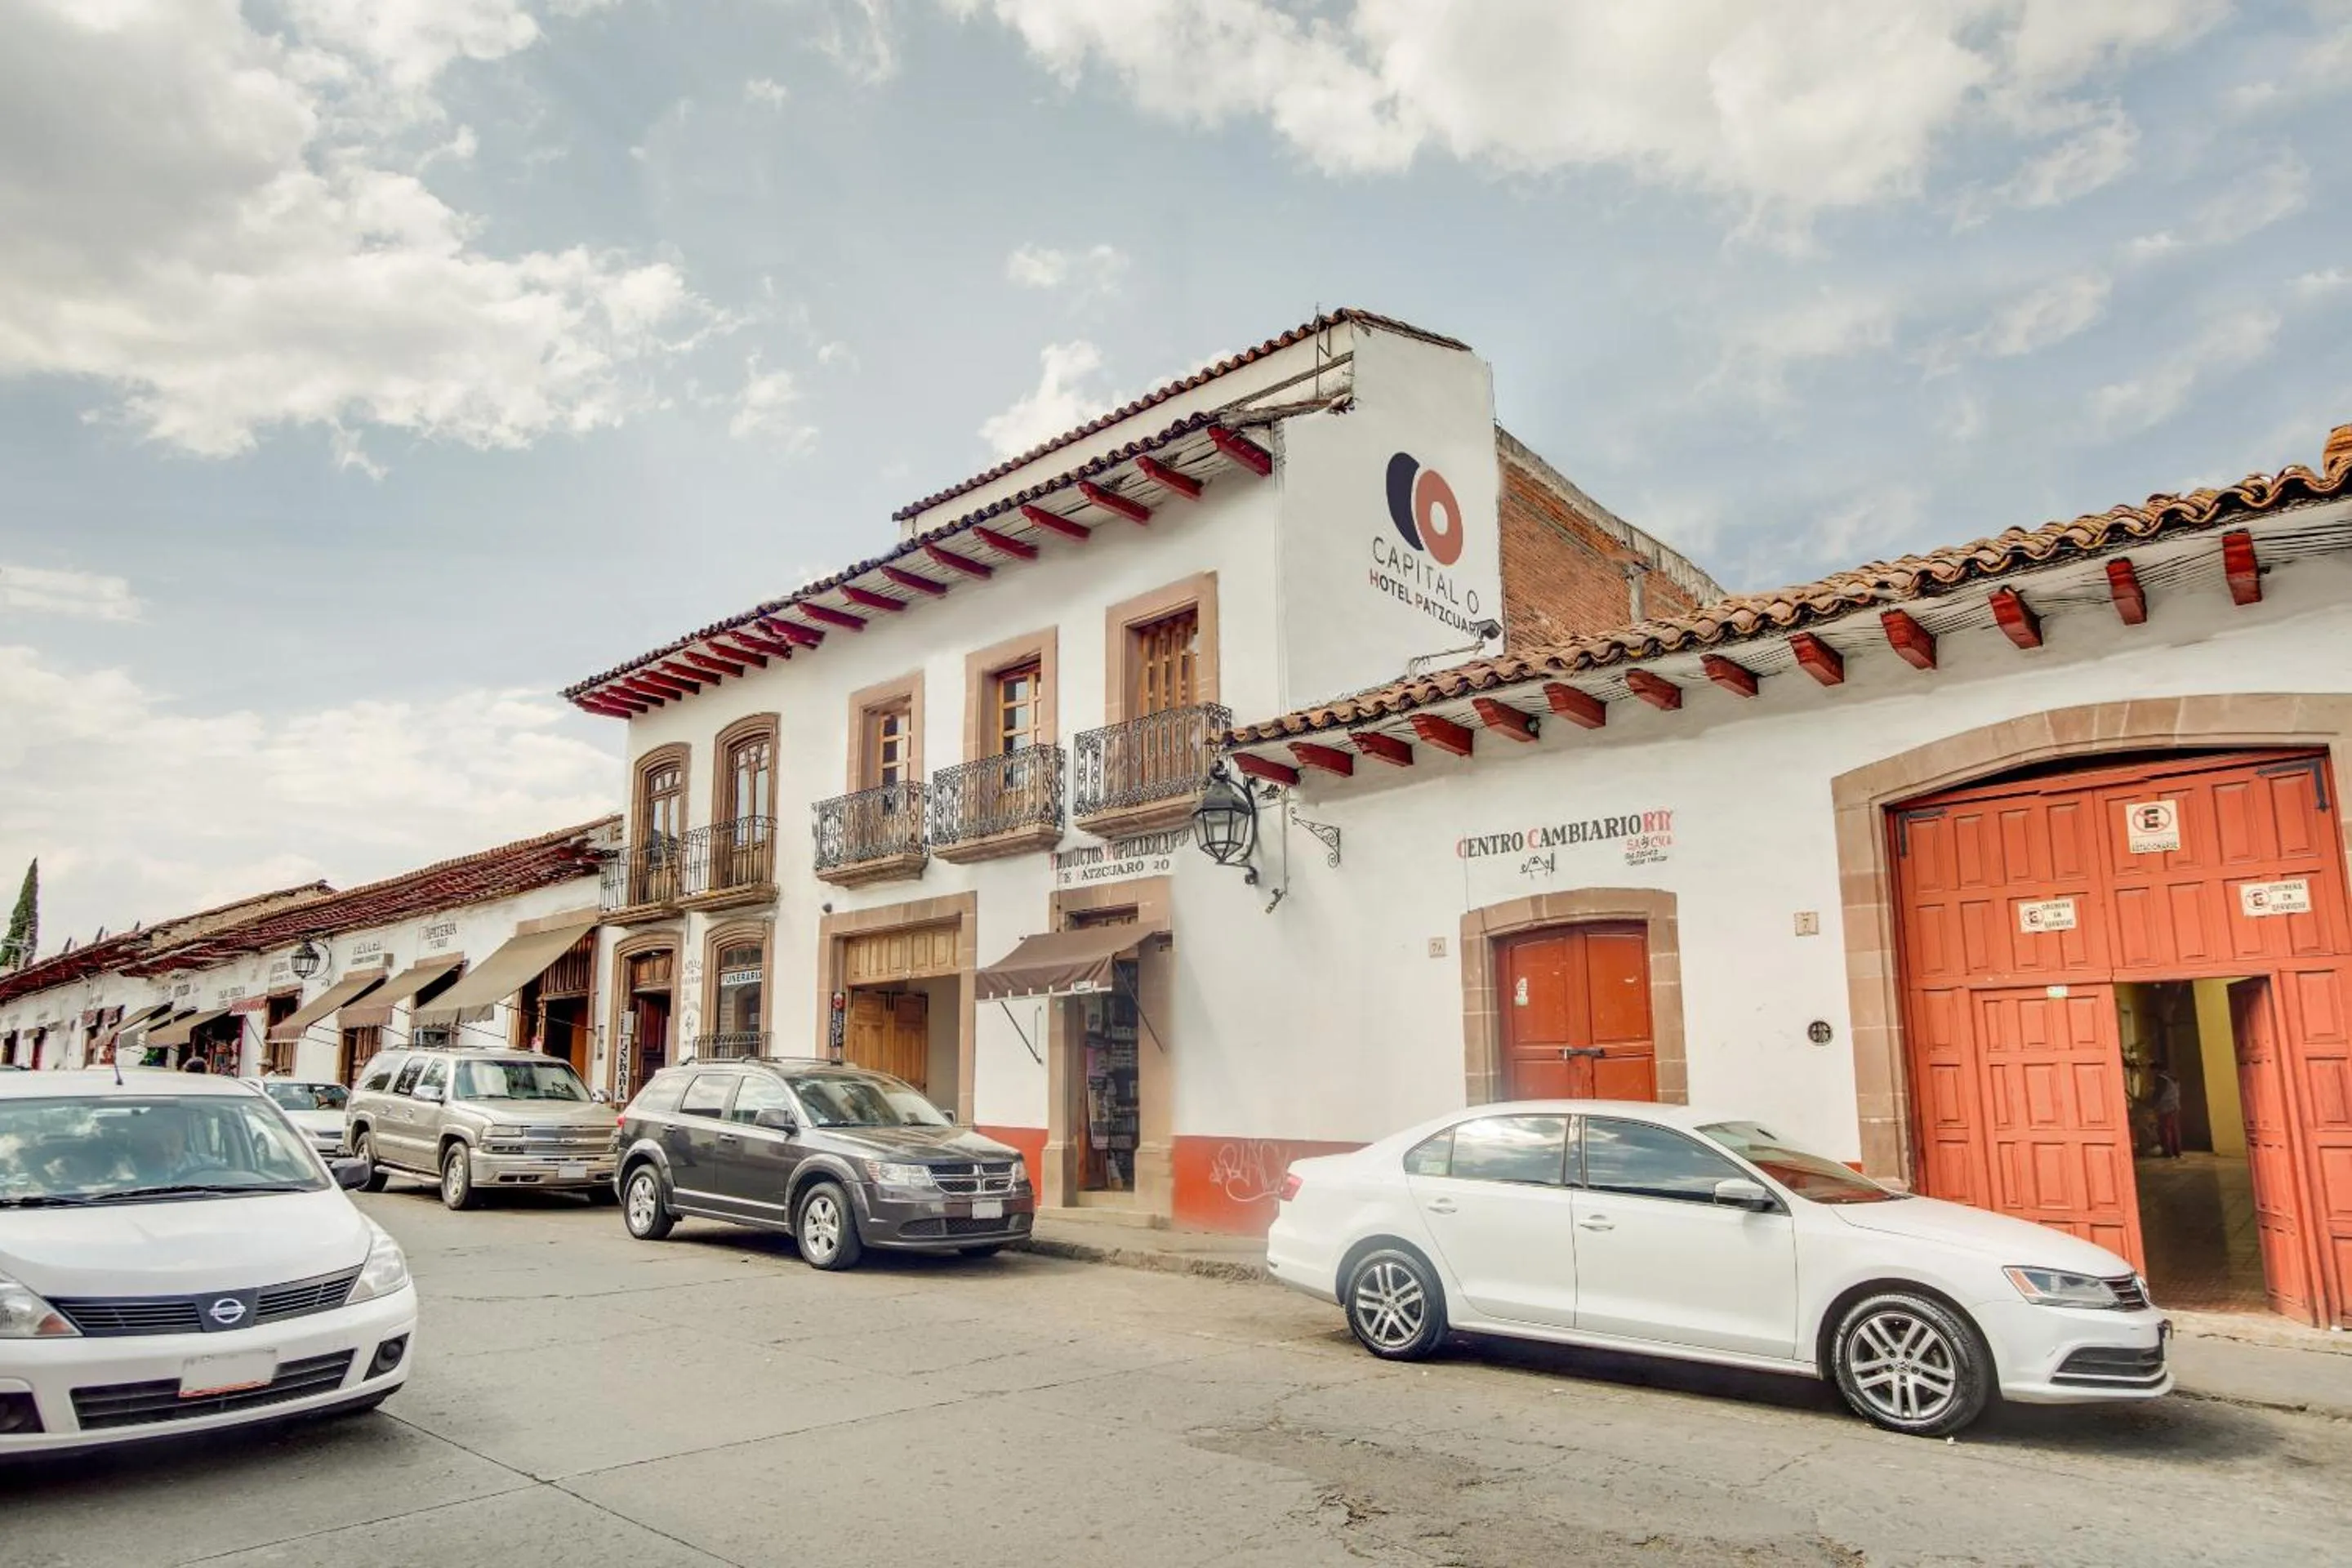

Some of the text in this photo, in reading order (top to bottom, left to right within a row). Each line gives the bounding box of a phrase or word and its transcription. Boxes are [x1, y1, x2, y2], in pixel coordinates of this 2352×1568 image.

[1369, 568, 1413, 605] HOTEL
[1456, 831, 1523, 859] CENTRO
[1527, 814, 1642, 852] CAMBIARIO
[1153, 858, 1169, 871] 20
